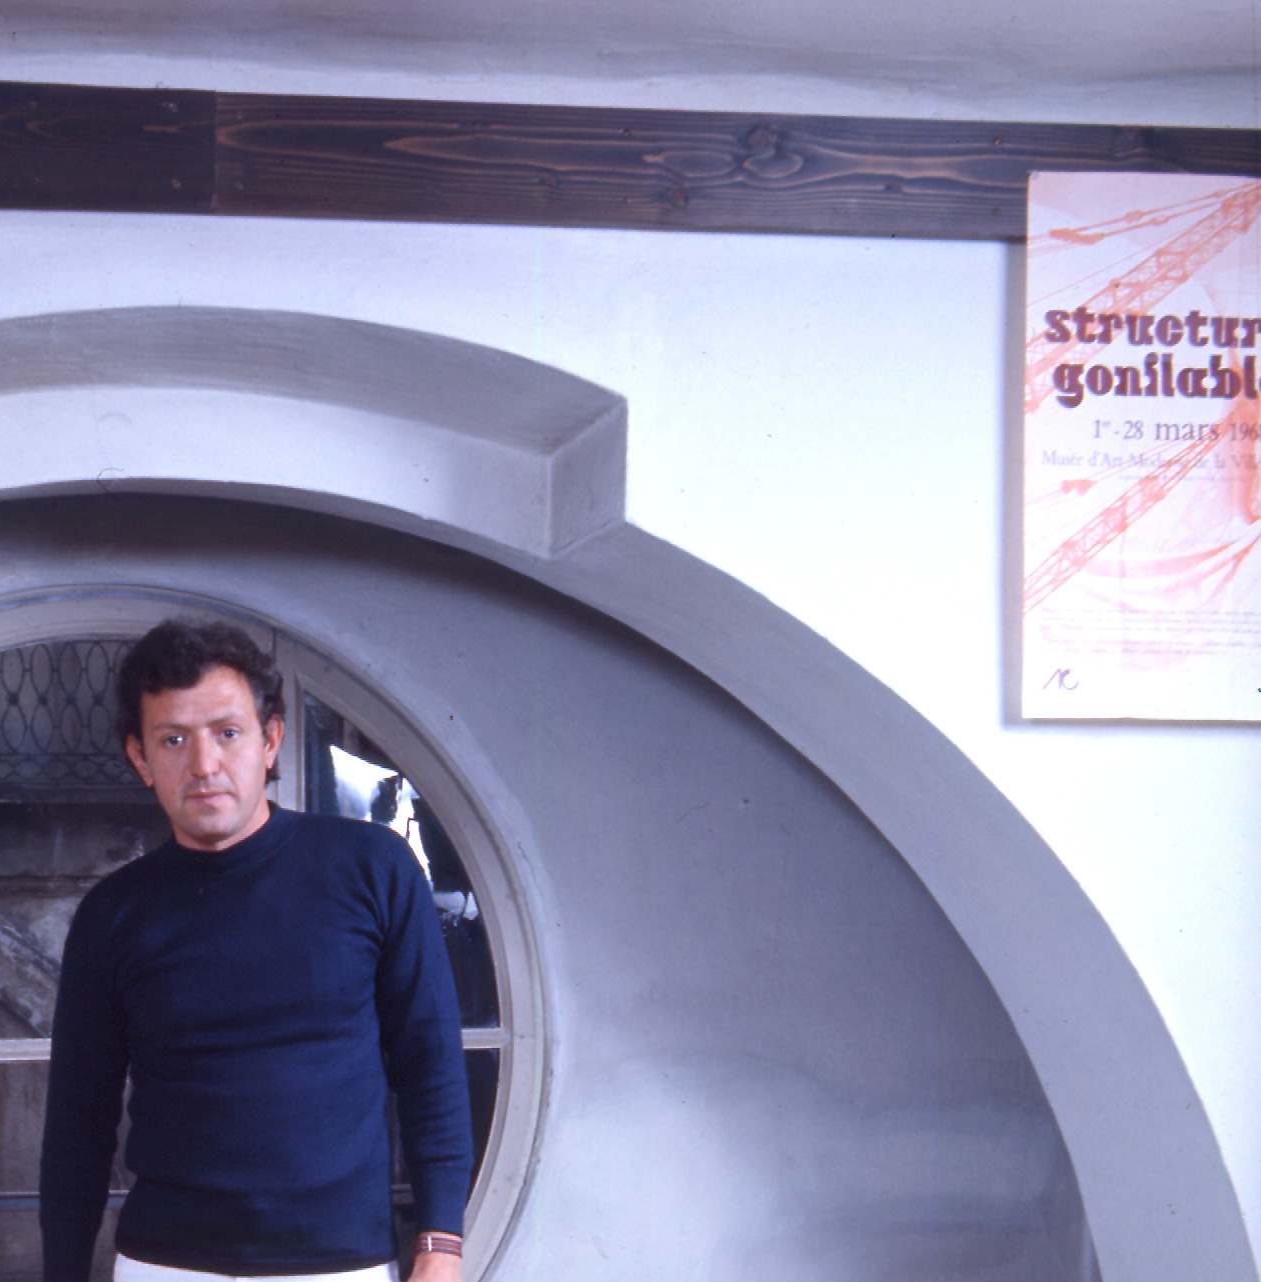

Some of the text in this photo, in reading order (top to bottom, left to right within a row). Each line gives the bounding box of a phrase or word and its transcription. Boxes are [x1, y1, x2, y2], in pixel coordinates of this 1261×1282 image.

[1044, 306, 1261, 348] structur
[1053, 352, 1261, 409] gonflabl
[1154, 422, 1220, 441] mars
